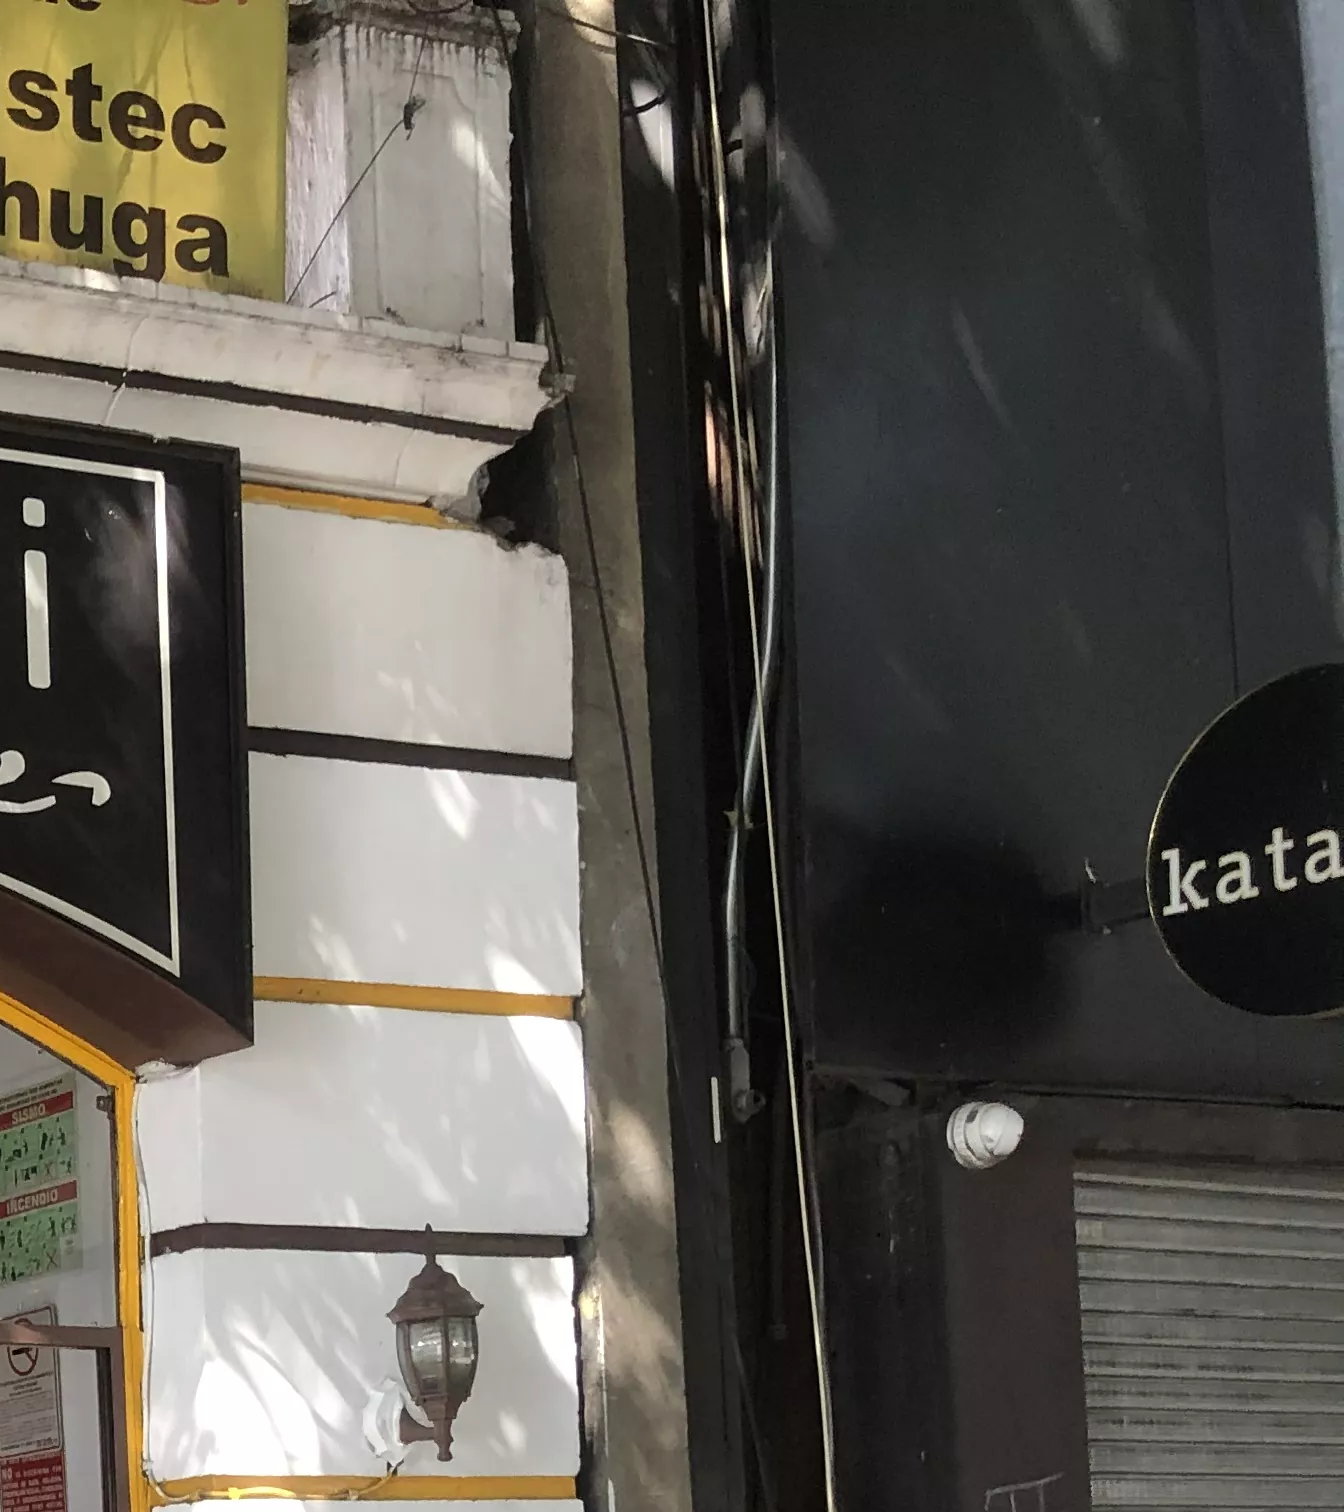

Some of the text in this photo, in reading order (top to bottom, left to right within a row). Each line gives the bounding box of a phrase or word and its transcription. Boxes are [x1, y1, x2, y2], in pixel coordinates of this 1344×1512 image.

[1160, 825, 1344, 918] kata
[11, 1103, 46, 1125] SISMO
[6, 1189, 59, 1215] INCENDIO
